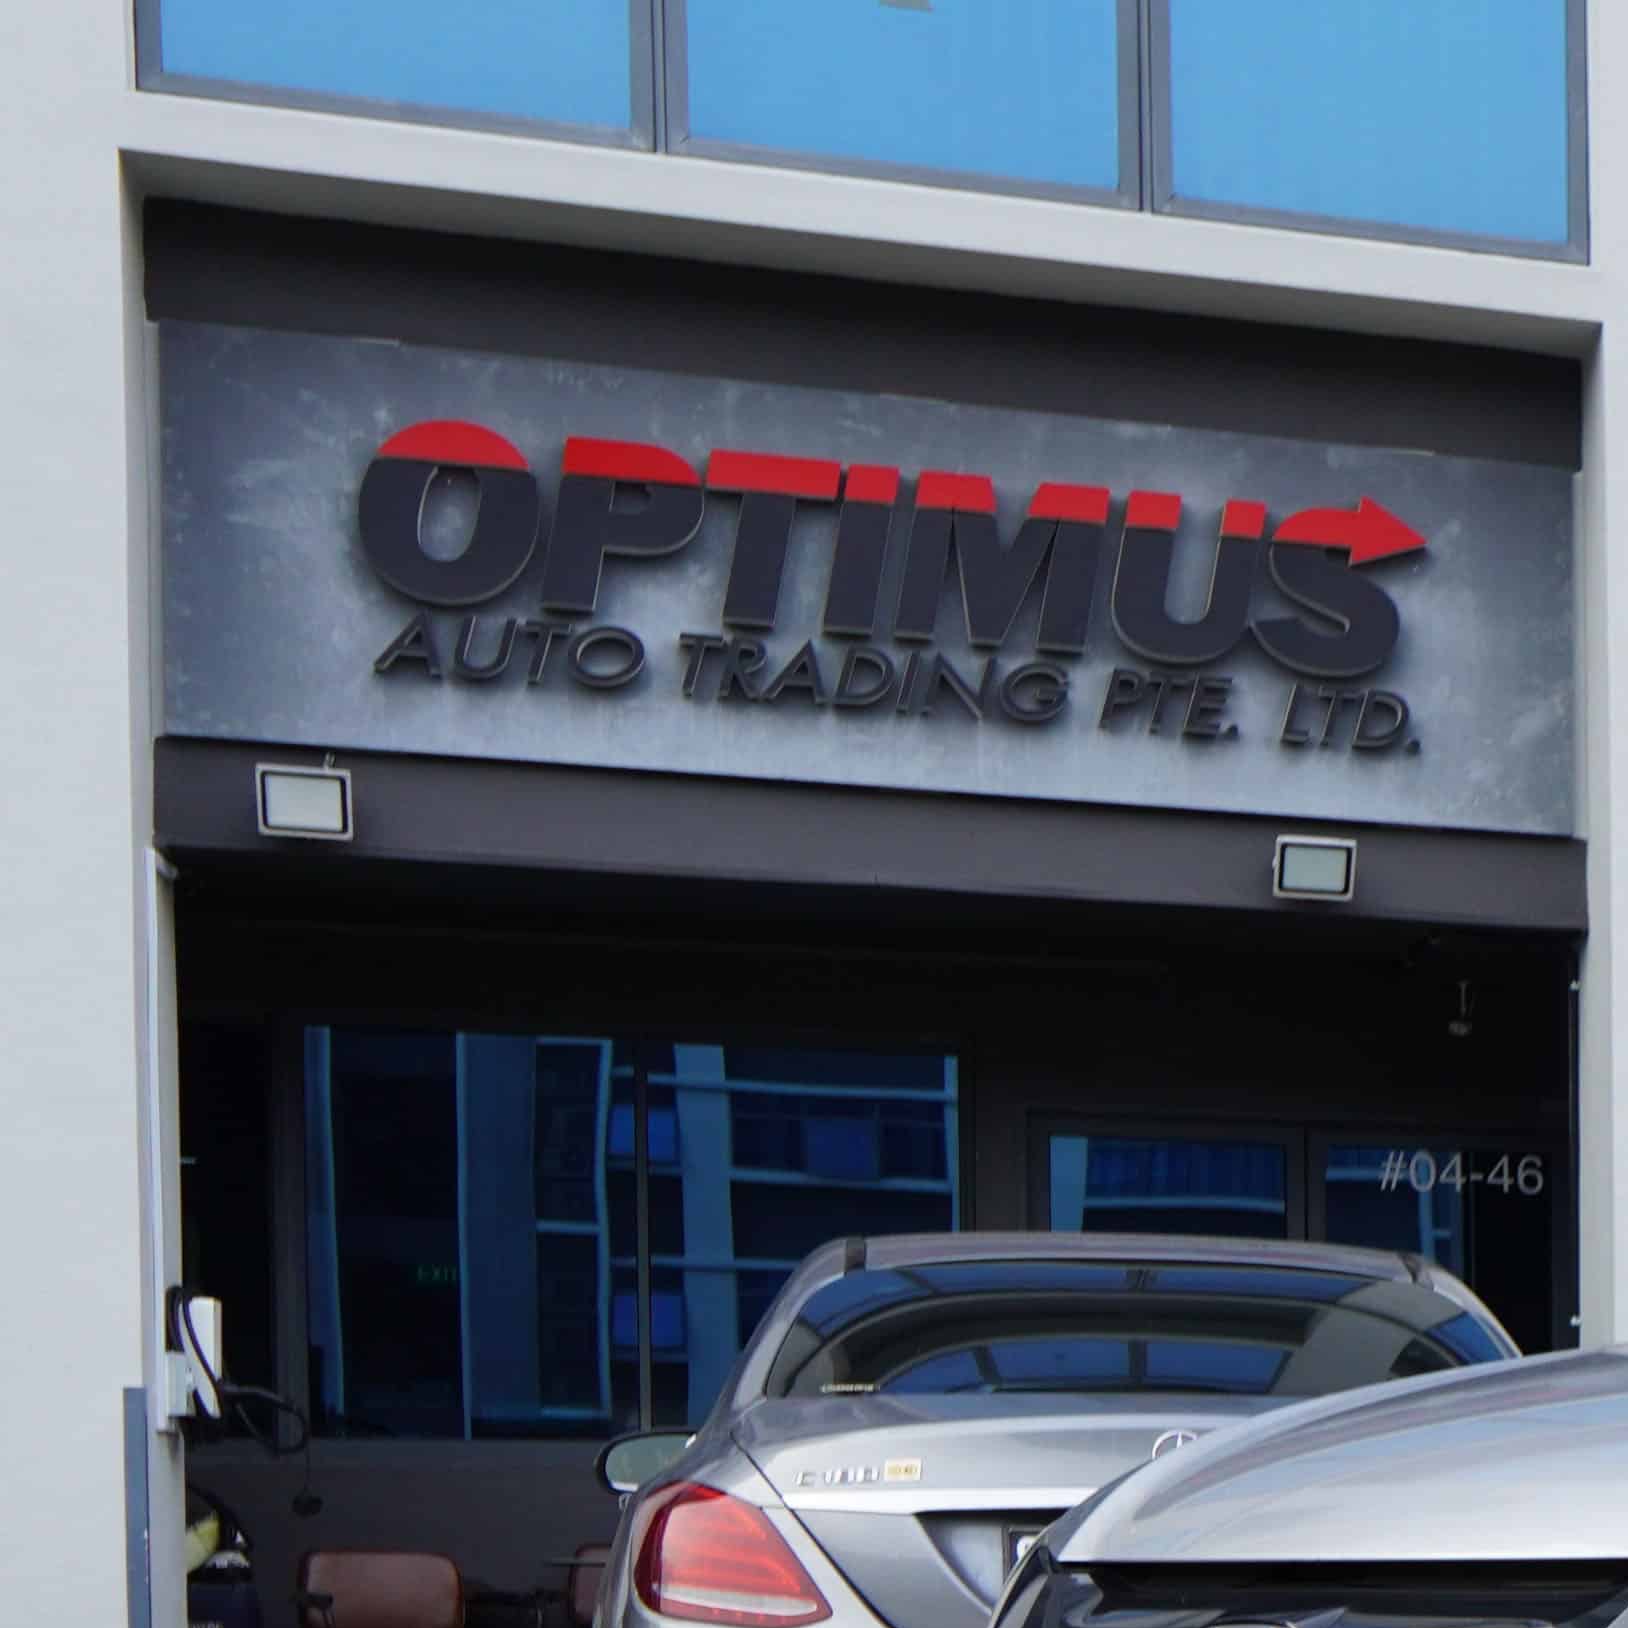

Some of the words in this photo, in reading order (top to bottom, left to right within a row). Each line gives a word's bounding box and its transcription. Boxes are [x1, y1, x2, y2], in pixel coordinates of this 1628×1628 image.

[358, 418, 1428, 680] OPTIMUS
[373, 608, 647, 691] AUTO
[678, 630, 1071, 724] TRADING
[1099, 665, 1240, 745] PTE.
[1279, 682, 1422, 756] LTD.
[1378, 1149, 1545, 1196] #04-46
